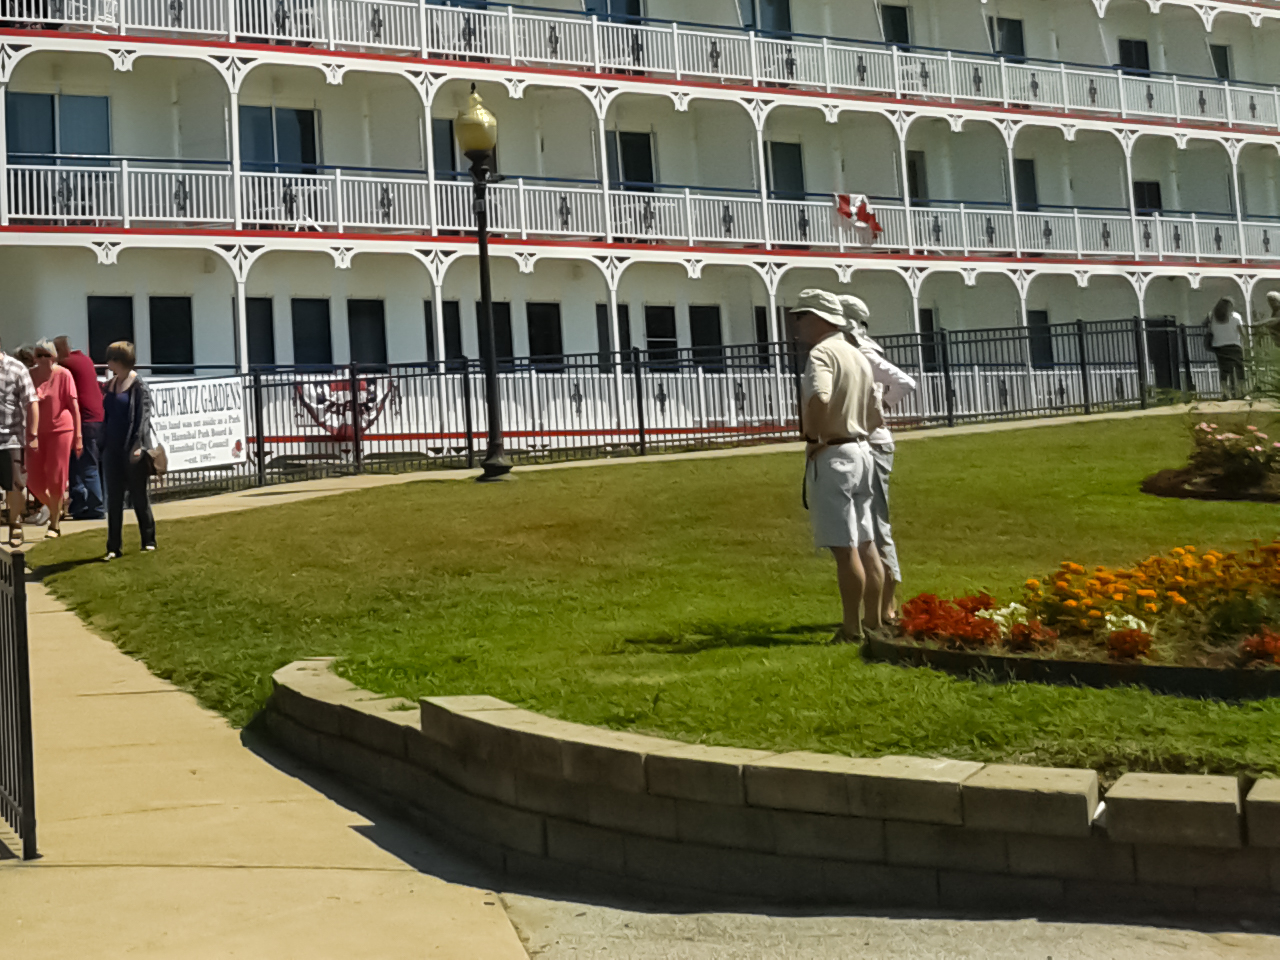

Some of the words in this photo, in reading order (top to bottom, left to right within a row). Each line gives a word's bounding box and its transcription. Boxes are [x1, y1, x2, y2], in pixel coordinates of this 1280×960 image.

[154, 421, 168, 431] This
[168, 420, 181, 429] land
[228, 414, 241, 424] Park
[163, 433, 170, 444] by
[171, 430, 197, 441] Hannibal
[197, 429, 210, 438] Park
[211, 427, 227, 437] Board
[169, 443, 195, 453] Hannibal
[196, 441, 207, 451] City
[208, 438, 229, 449] Council
